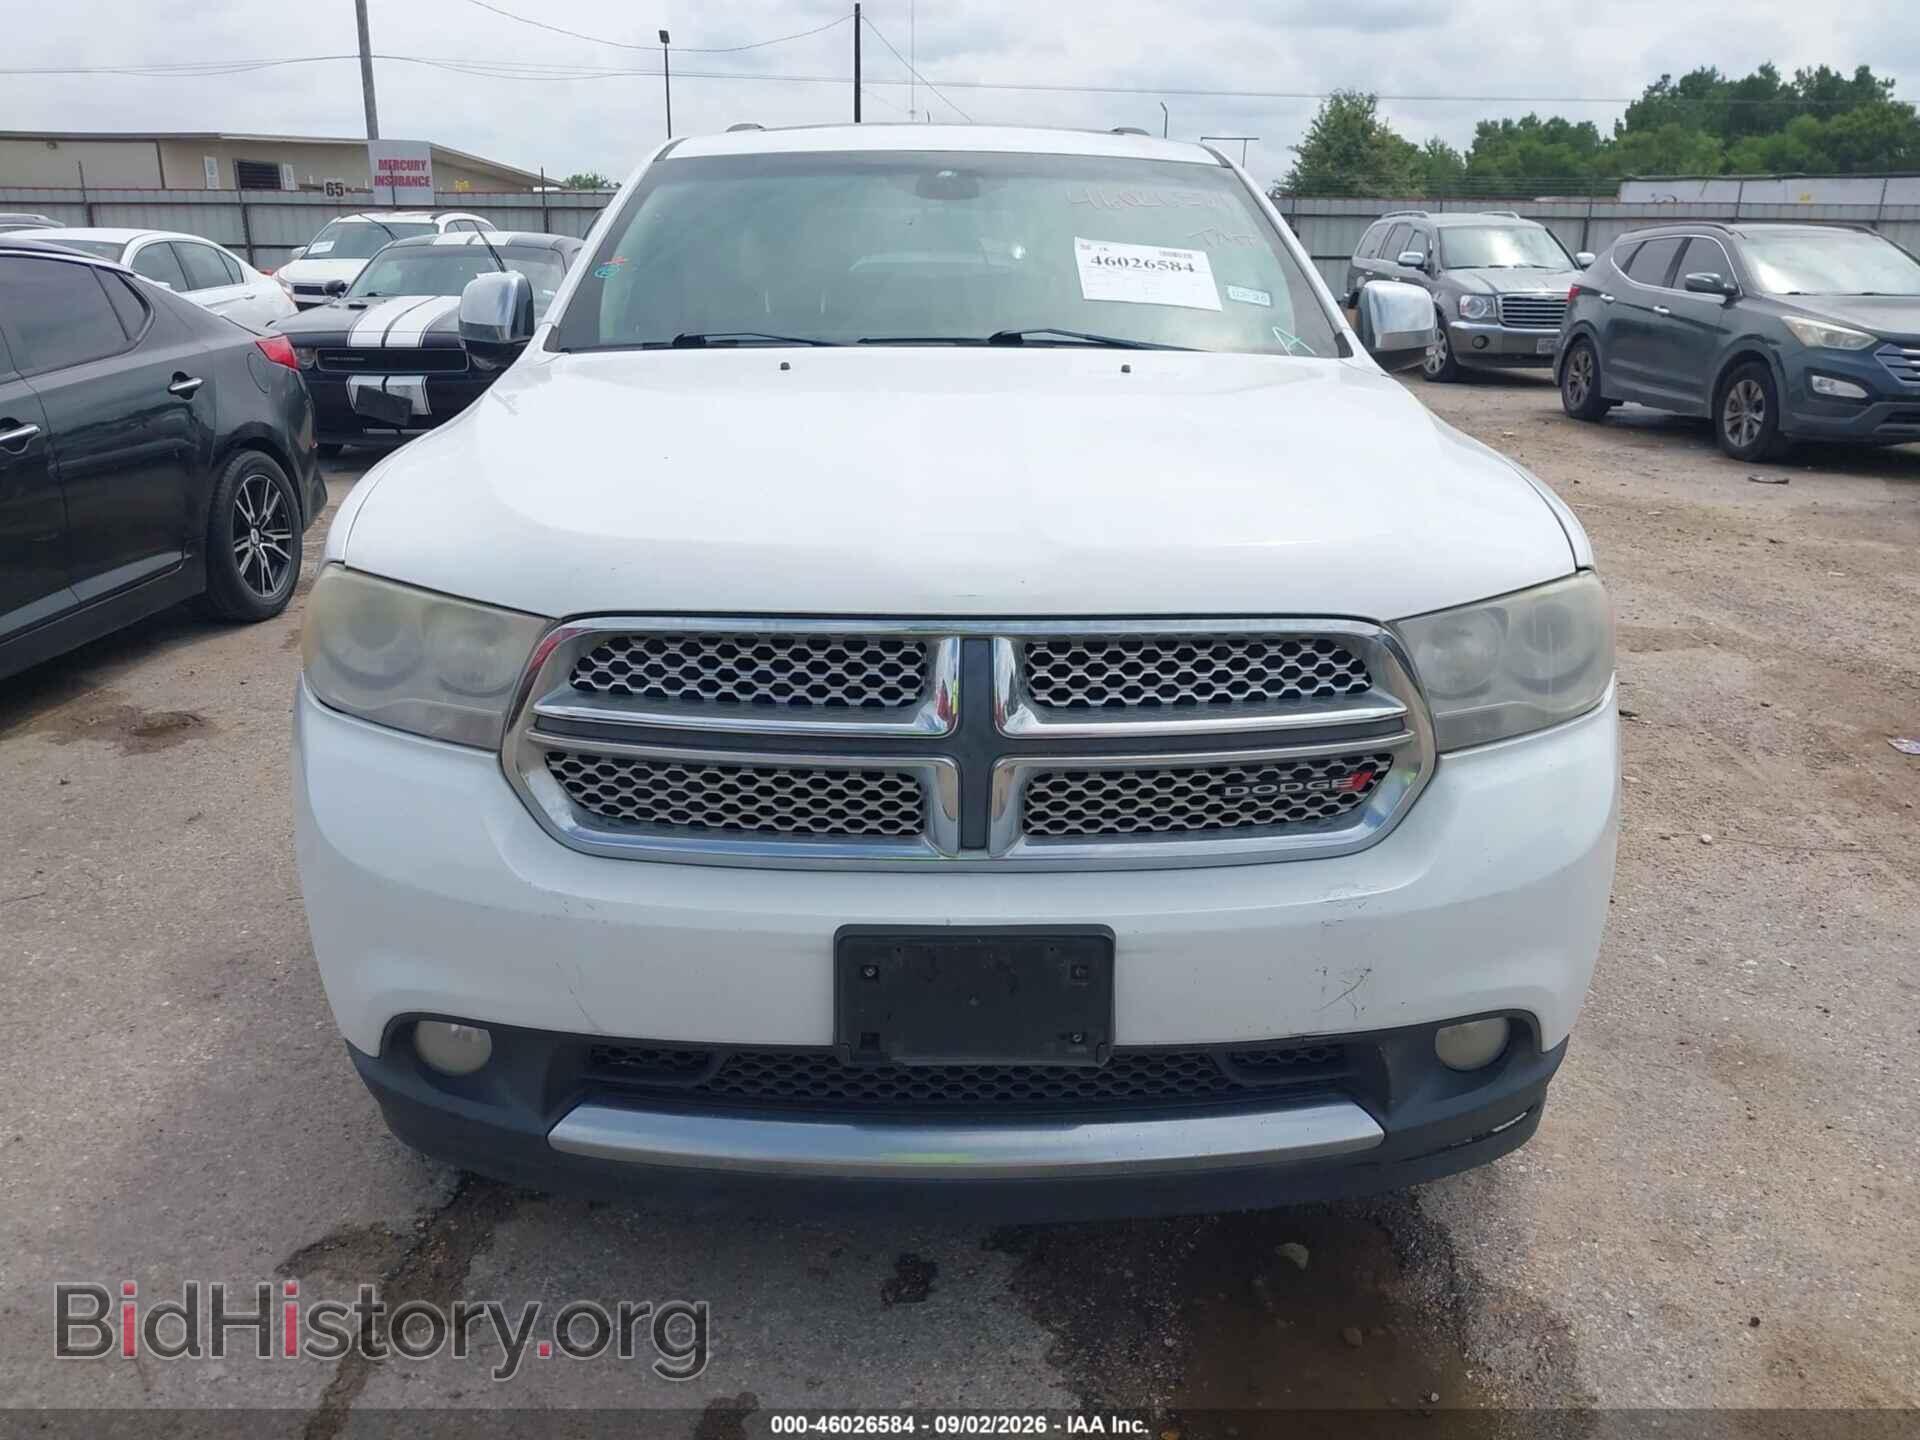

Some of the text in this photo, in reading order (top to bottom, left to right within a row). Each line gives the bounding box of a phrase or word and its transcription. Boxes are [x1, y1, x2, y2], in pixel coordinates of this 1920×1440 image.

[378, 159, 426, 171] MERCURY
[325, 181, 344, 197] 65
[374, 175, 431, 187] INSURANCE
[1090, 254, 1195, 273] 46026584
[1225, 778, 1353, 796] DODGE
